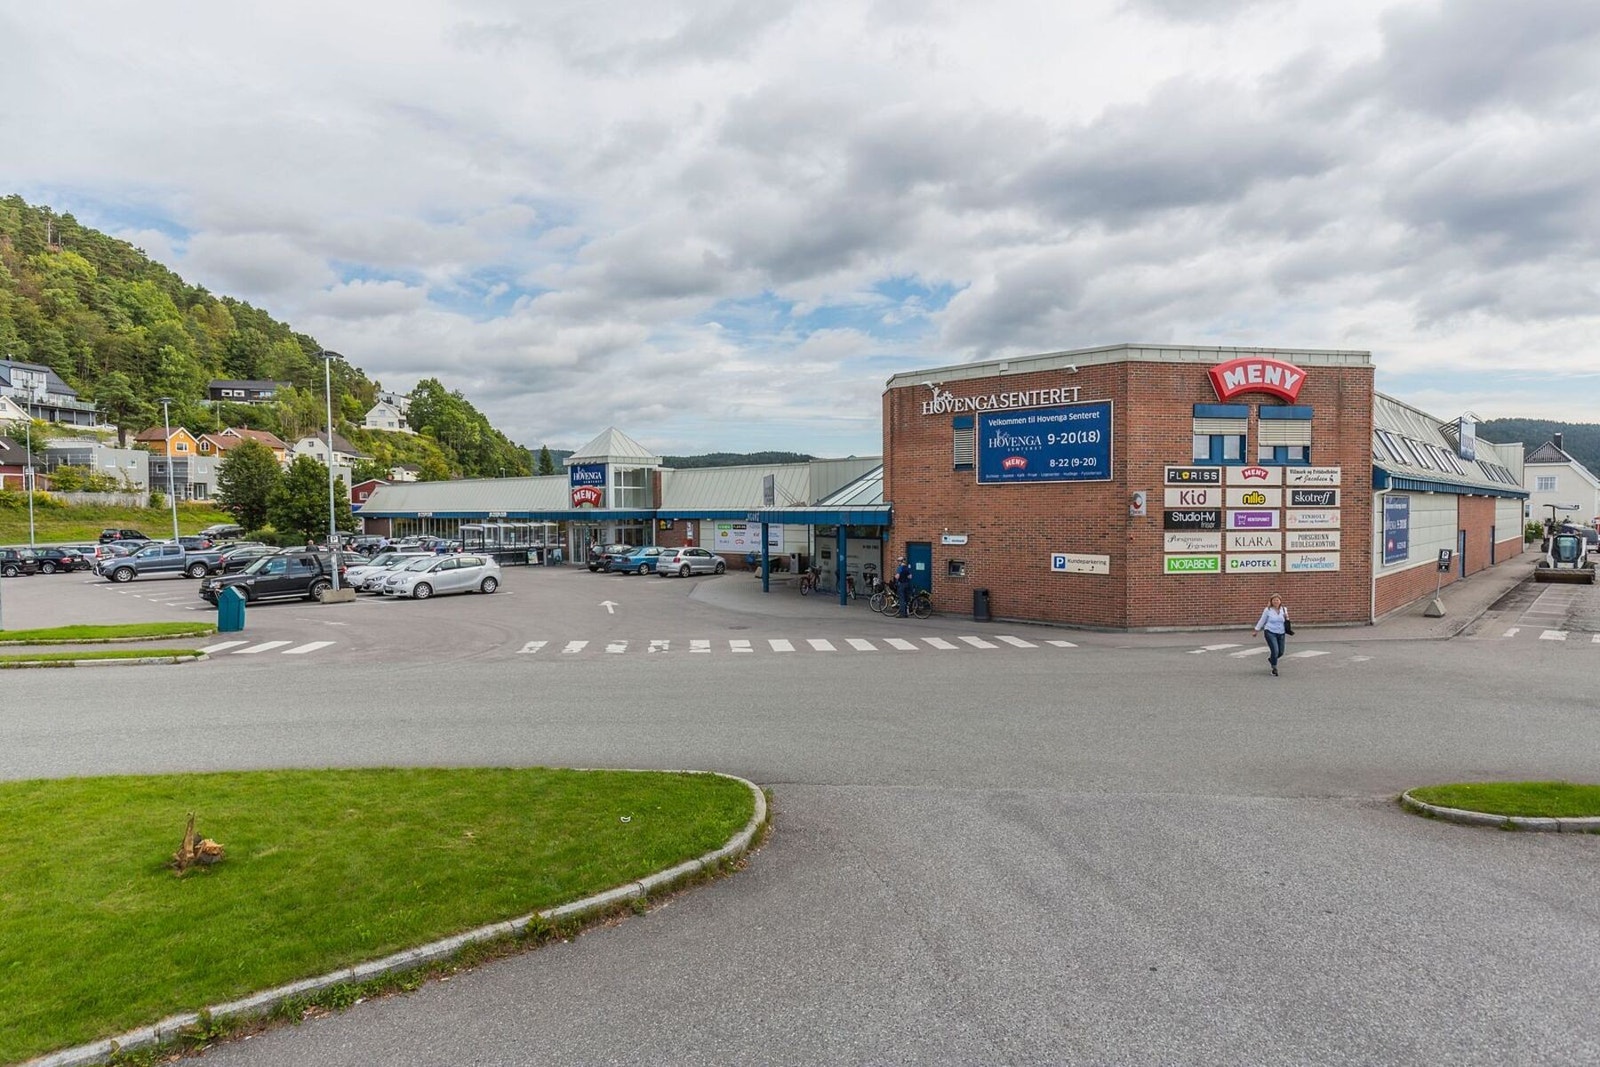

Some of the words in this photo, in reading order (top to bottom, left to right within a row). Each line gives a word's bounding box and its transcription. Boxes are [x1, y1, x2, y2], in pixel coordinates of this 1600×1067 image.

[1223, 364, 1300, 390] MENY
[988, 416, 1026, 426] Velkommen
[1037, 414, 1067, 423] Hovenga
[1069, 411, 1100, 420] Senteret
[989, 435, 1042, 448] HOVENGA
[1048, 430, 1100, 445] 9-20(18)
[1005, 458, 1025, 467] MENY
[1050, 459, 1068, 467] 8-22
[1071, 457, 1097, 467] (9-20)
[573, 472, 602, 480] HOVENGA
[1169, 472, 1217, 480] FLORISS
[1244, 469, 1266, 477] MENY
[573, 490, 597, 502] MENY
[1180, 490, 1207, 505] Kid
[1243, 492, 1265, 504] nille
[1294, 491, 1332, 505] skotreff
[1235, 537, 1273, 547] KLARA
[1170, 560, 1215, 569] NOTABENE
